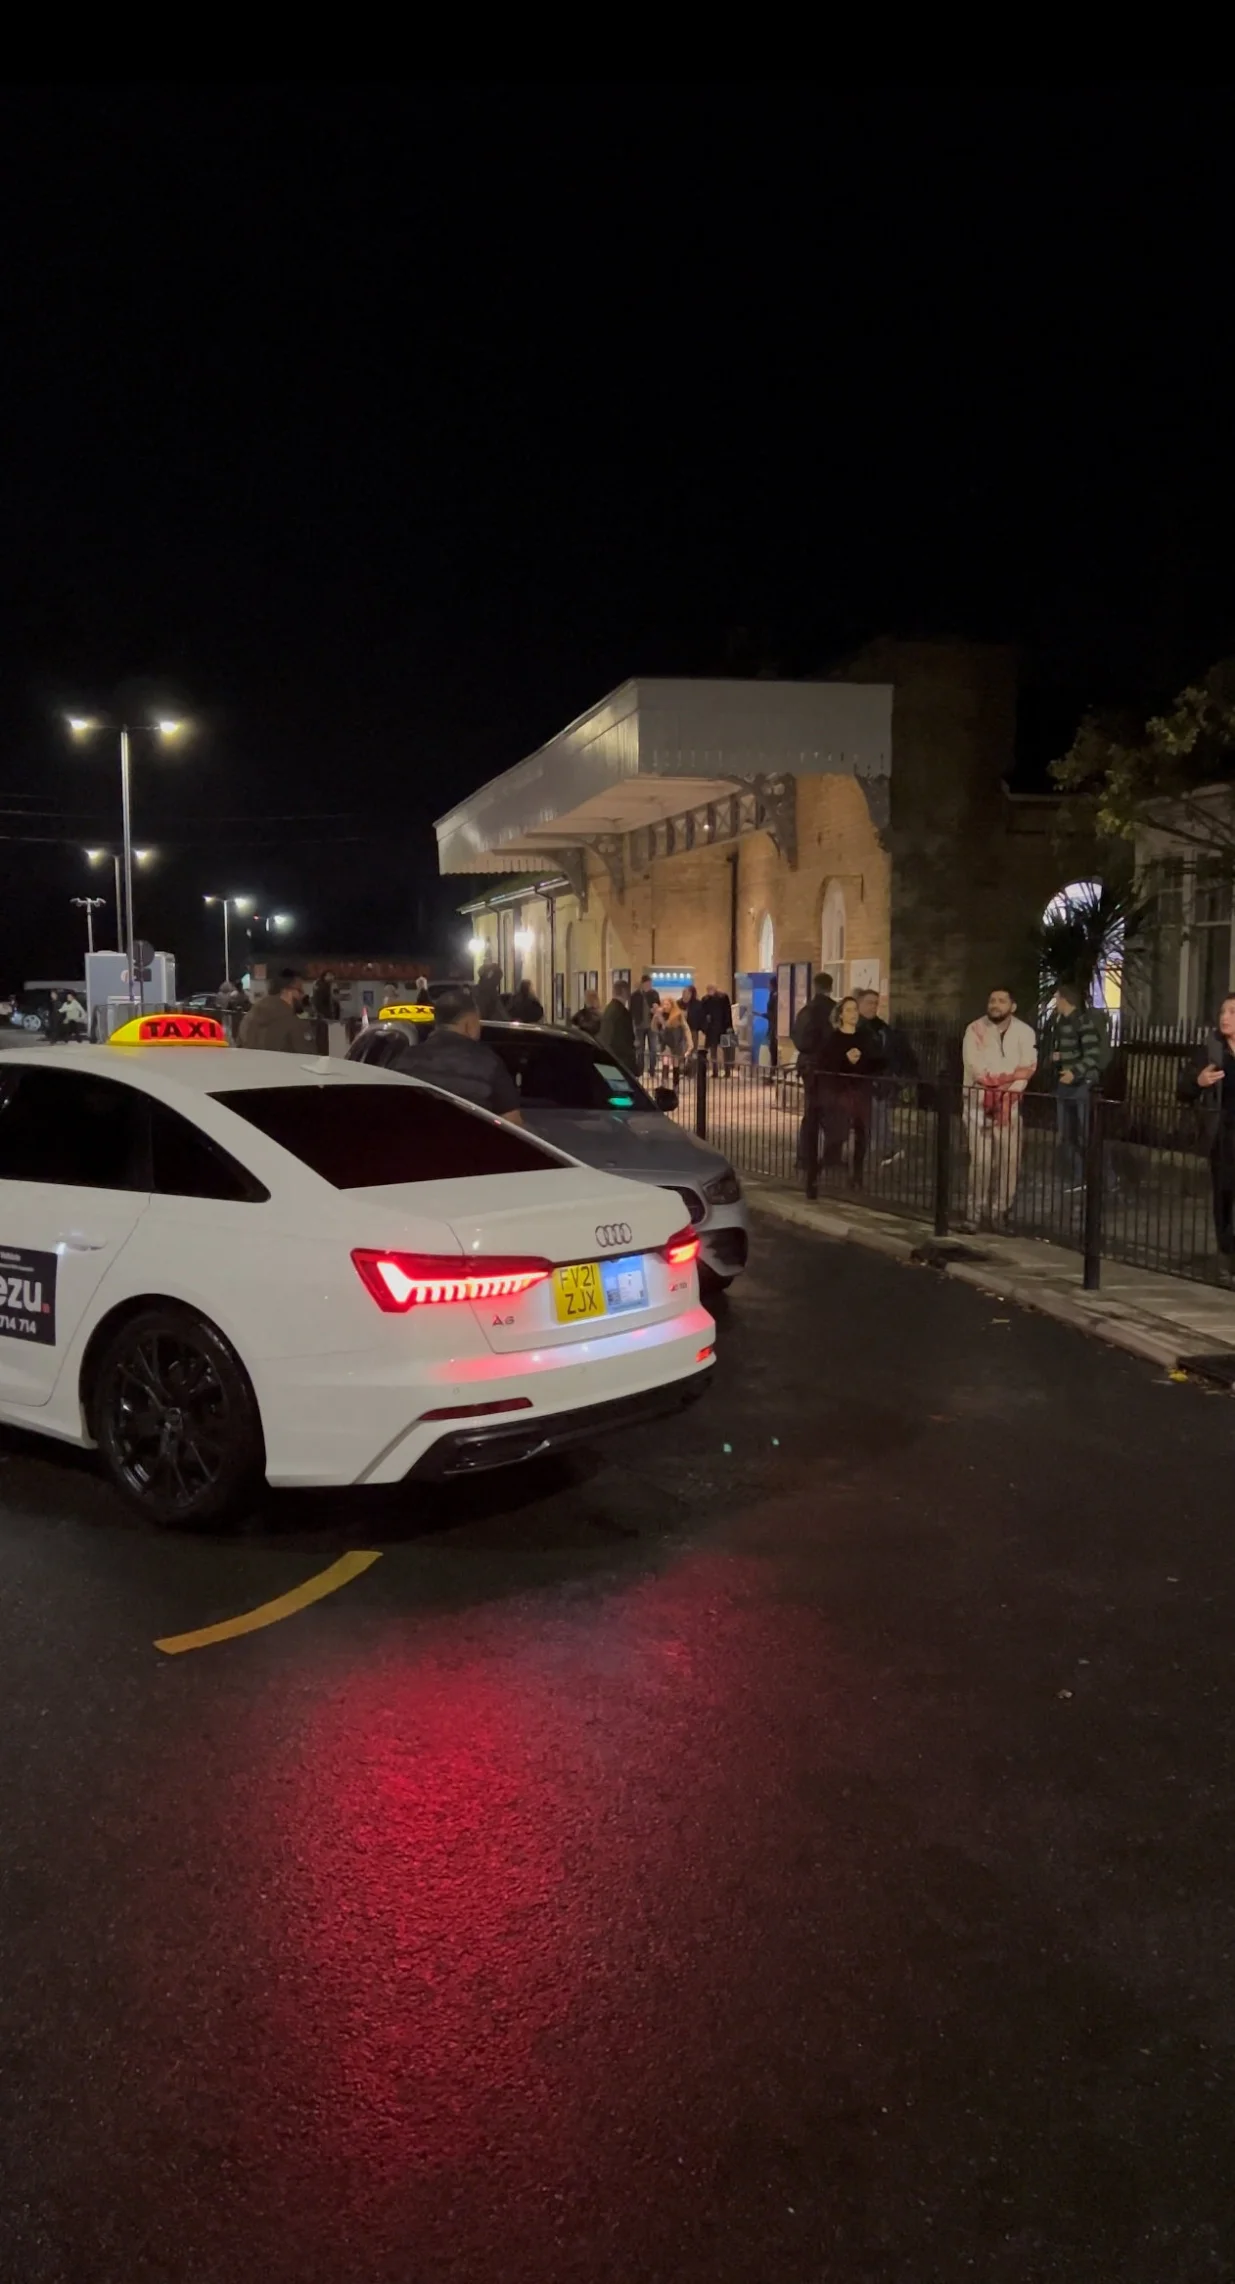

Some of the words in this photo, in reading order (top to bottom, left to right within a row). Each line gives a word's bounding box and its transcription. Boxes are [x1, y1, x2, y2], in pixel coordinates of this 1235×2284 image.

[144, 1021, 217, 1038] TAXI
[559, 1265, 595, 1290] FV21
[564, 1289, 597, 1315] ZJX
[18, 1318, 37, 1334] 714
